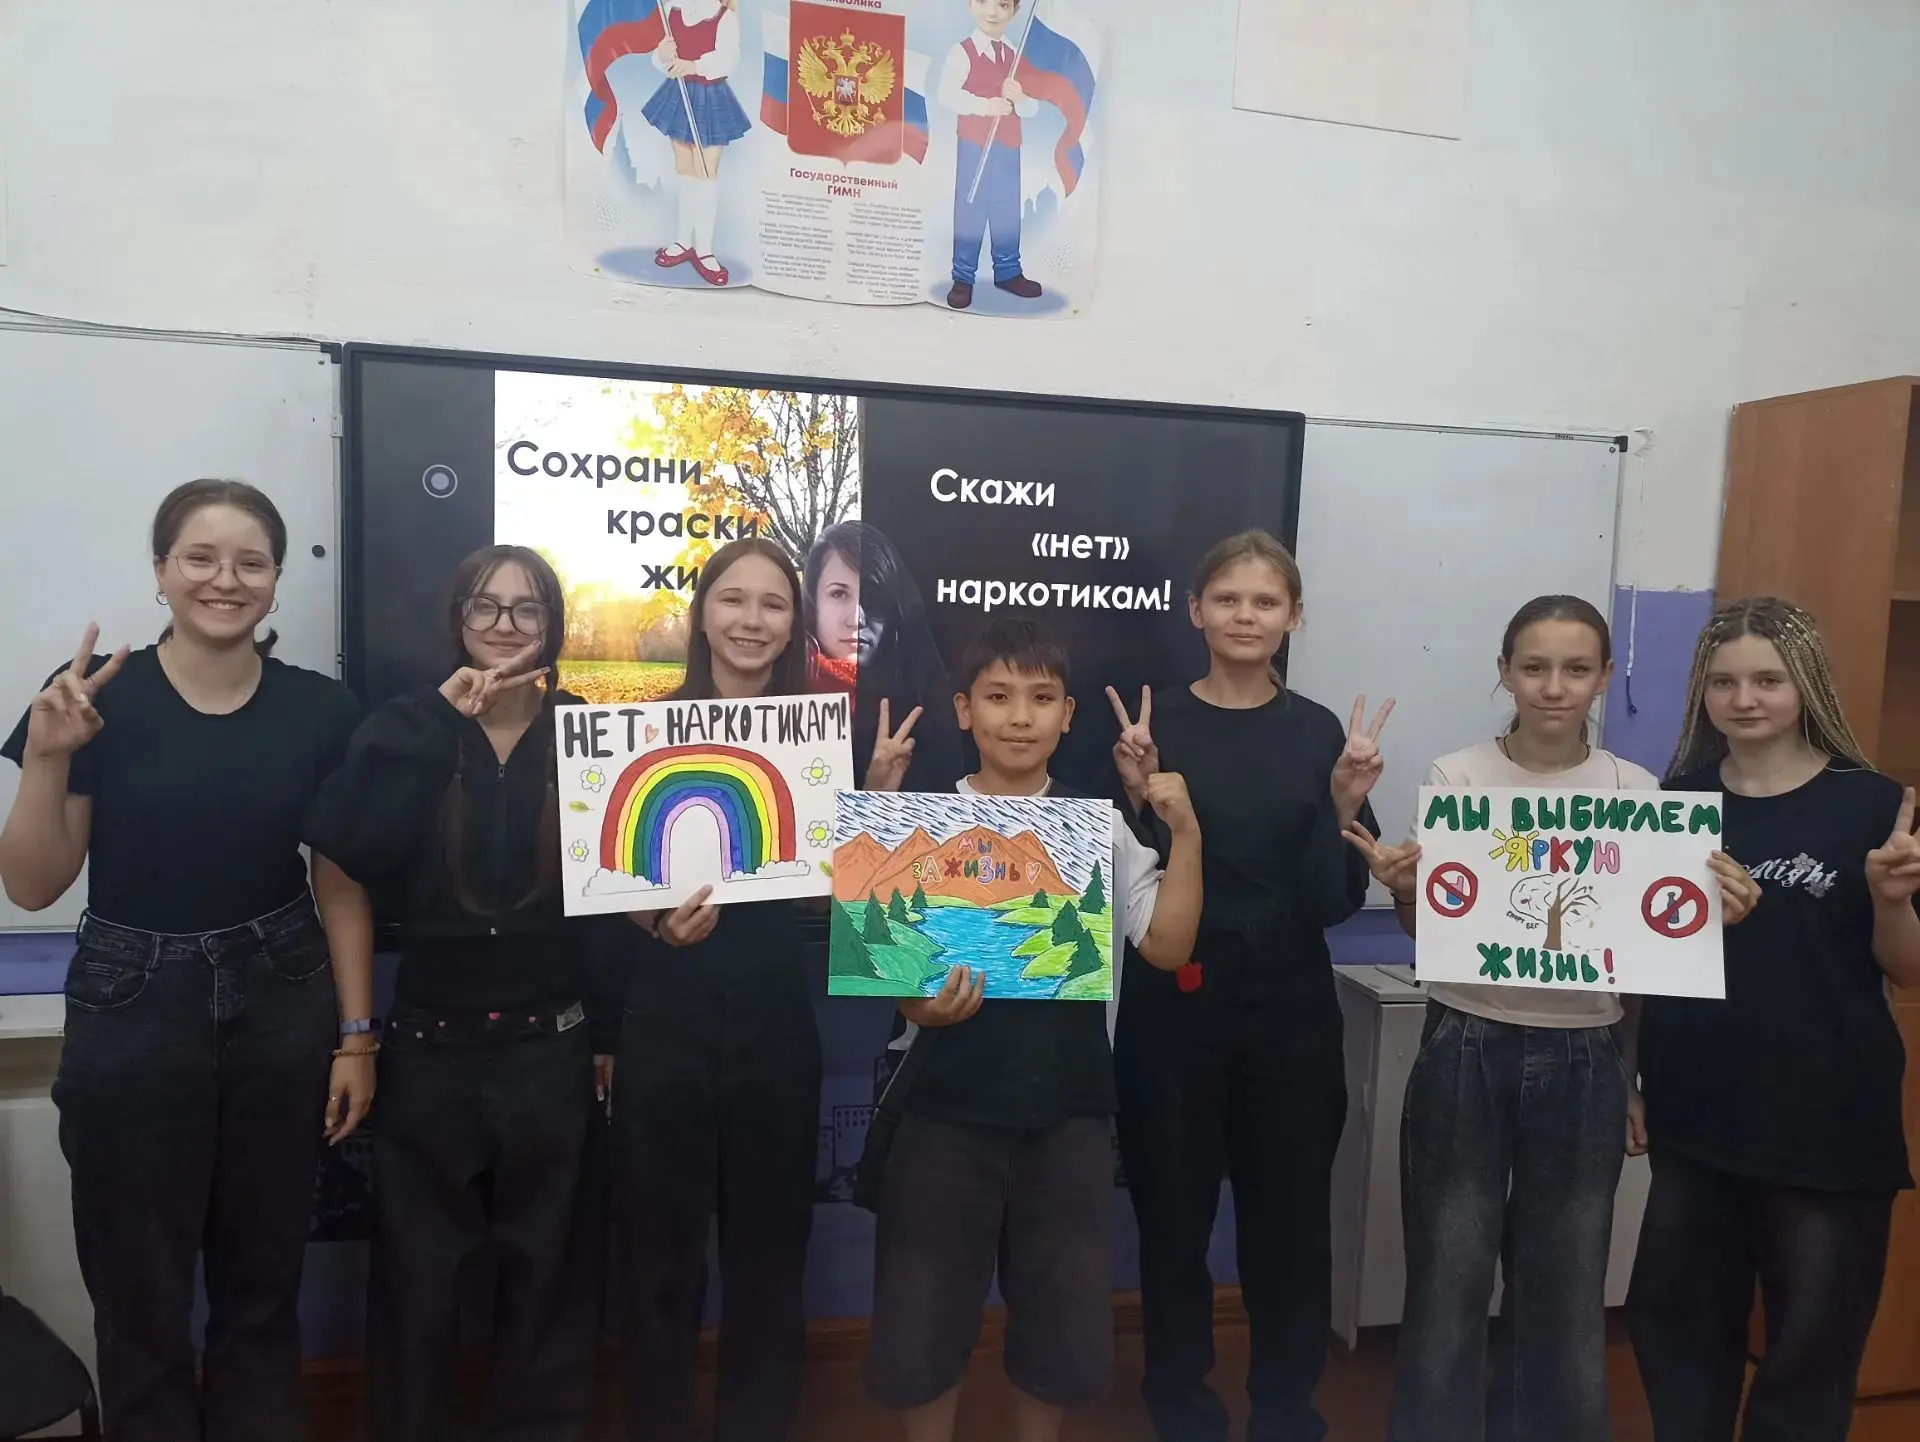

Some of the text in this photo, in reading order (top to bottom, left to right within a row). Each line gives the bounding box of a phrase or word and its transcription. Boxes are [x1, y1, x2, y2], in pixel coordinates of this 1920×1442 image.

[790, 168, 898, 190] Государственный
[507, 440, 701, 488] Сохрани
[930, 468, 1055, 507] Скажи
[608, 509, 757, 543] краски
[1031, 532, 1130, 560] «нет»
[640, 564, 700, 591] жи
[937, 578, 1171, 612] наркотикам!
[563, 697, 847, 758] НЕТ НАРКОТИКАМ!
[1424, 795, 1490, 831] МЫ
[958, 836, 992, 853] МЫ
[1505, 836, 1620, 875] ЯРКУЮ
[911, 856, 1020, 884] ЗА ЖИЗНЬ
[1476, 942, 1615, 984] ЖИЗНЬ!
